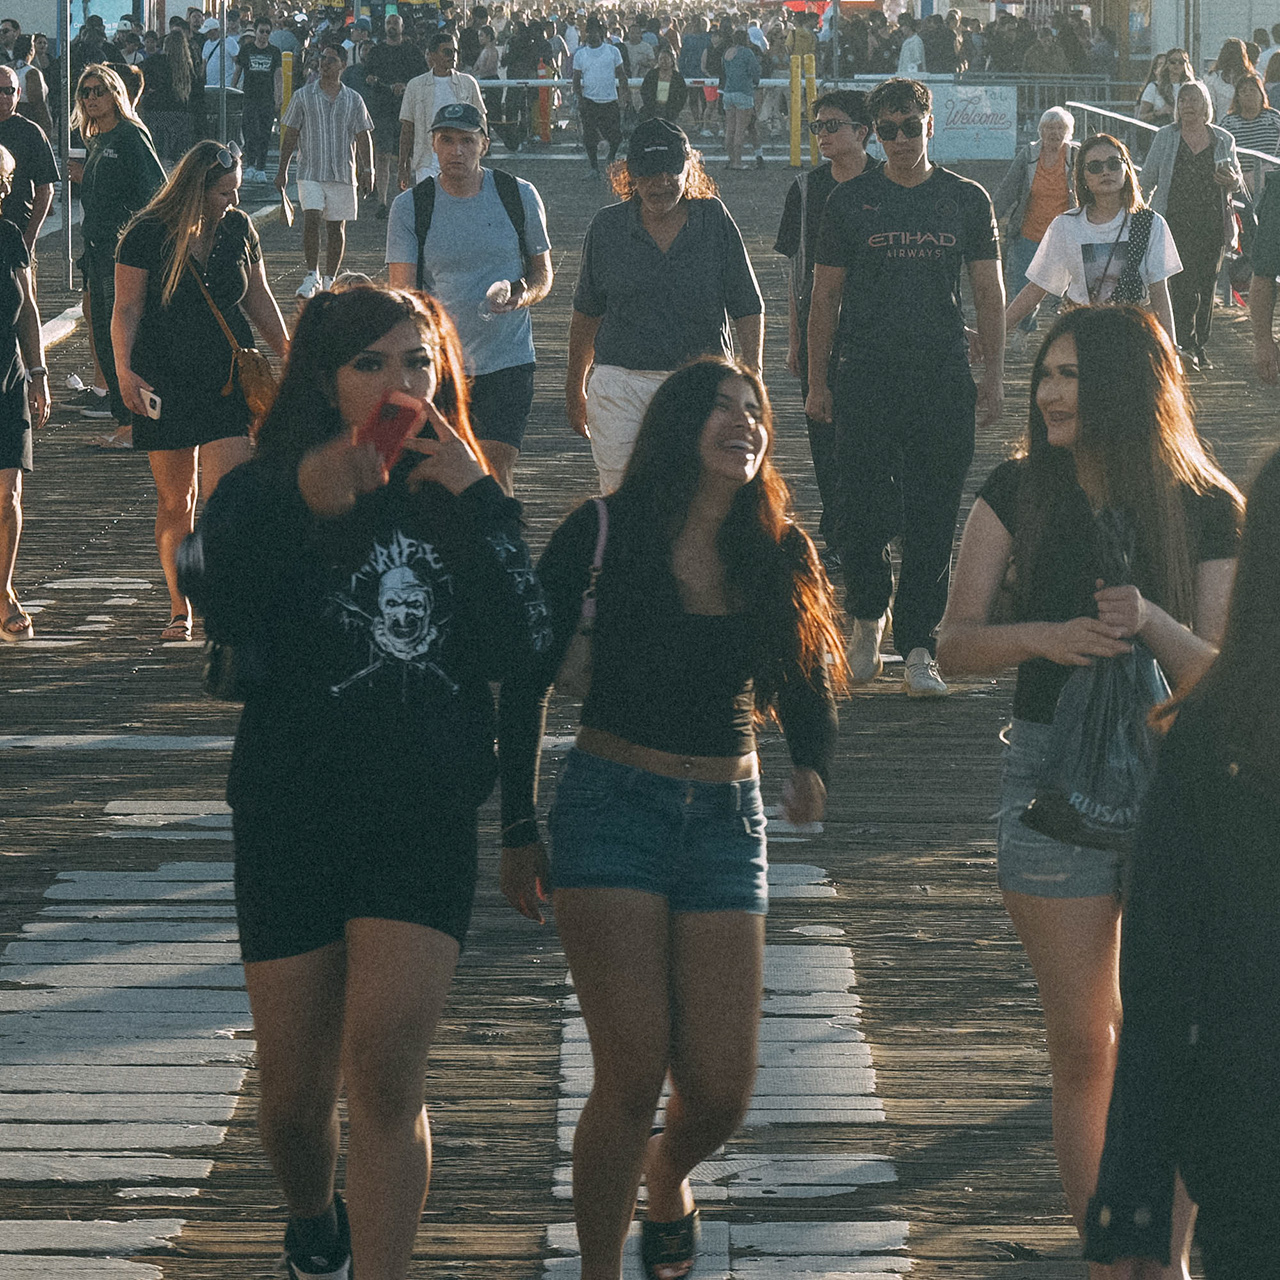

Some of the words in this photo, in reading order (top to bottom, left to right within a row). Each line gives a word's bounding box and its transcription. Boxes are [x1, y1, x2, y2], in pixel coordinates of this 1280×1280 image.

[944, 96, 1008, 127] Welcome
[868, 231, 956, 248] ETIHAD
[886, 249, 941, 258] AIRWAYS
